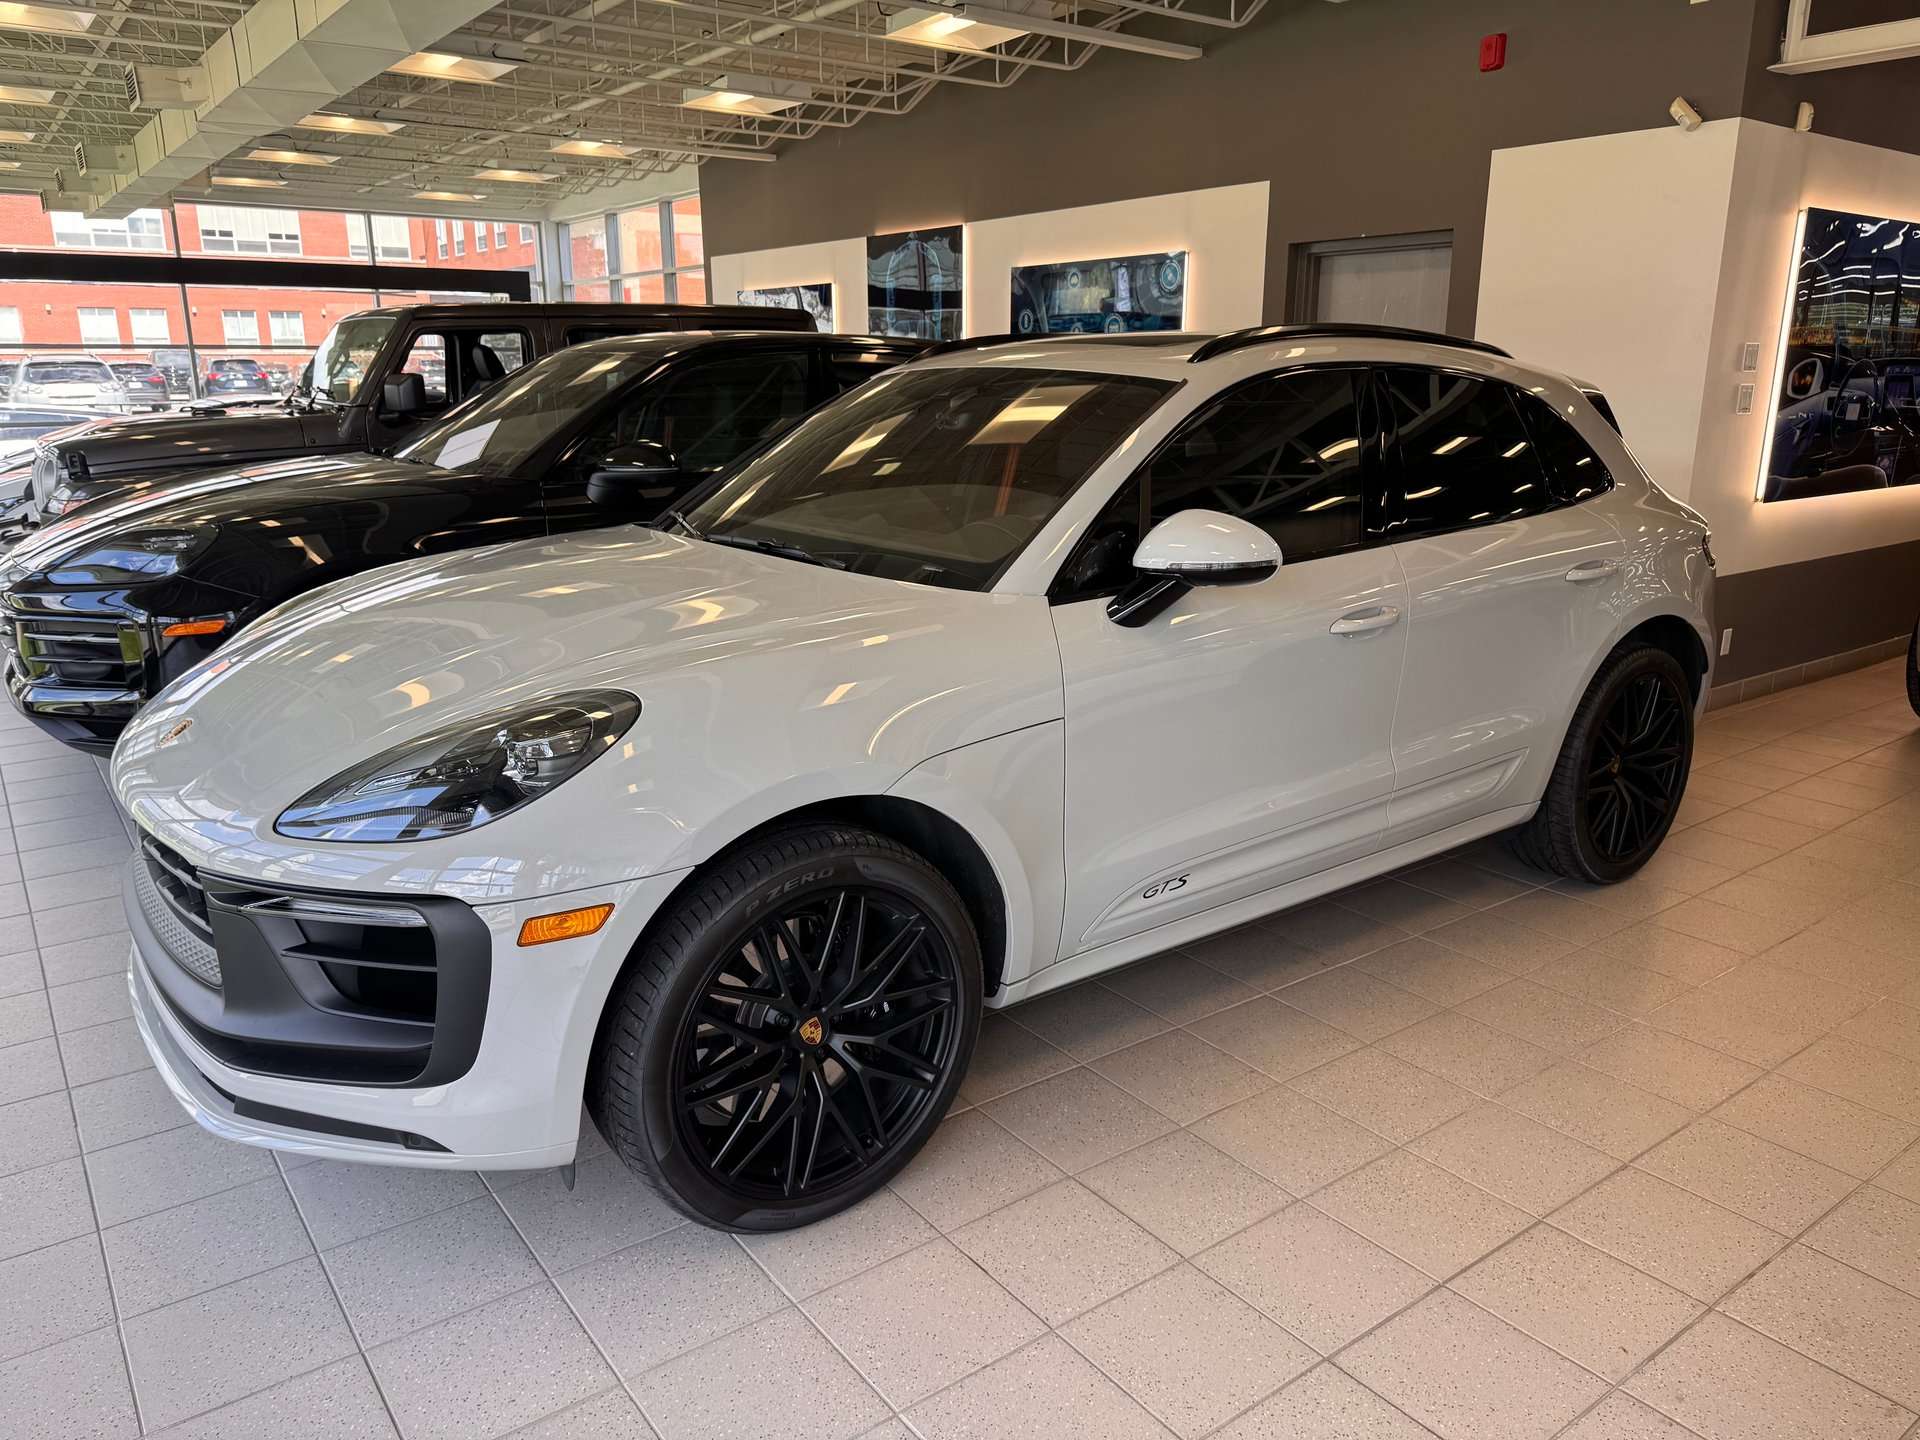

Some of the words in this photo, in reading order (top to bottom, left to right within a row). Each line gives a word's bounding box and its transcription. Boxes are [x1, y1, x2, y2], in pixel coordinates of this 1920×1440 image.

[745, 899, 760, 919] P
[766, 867, 834, 903] ZERO
[1143, 873, 1190, 899] GTS
